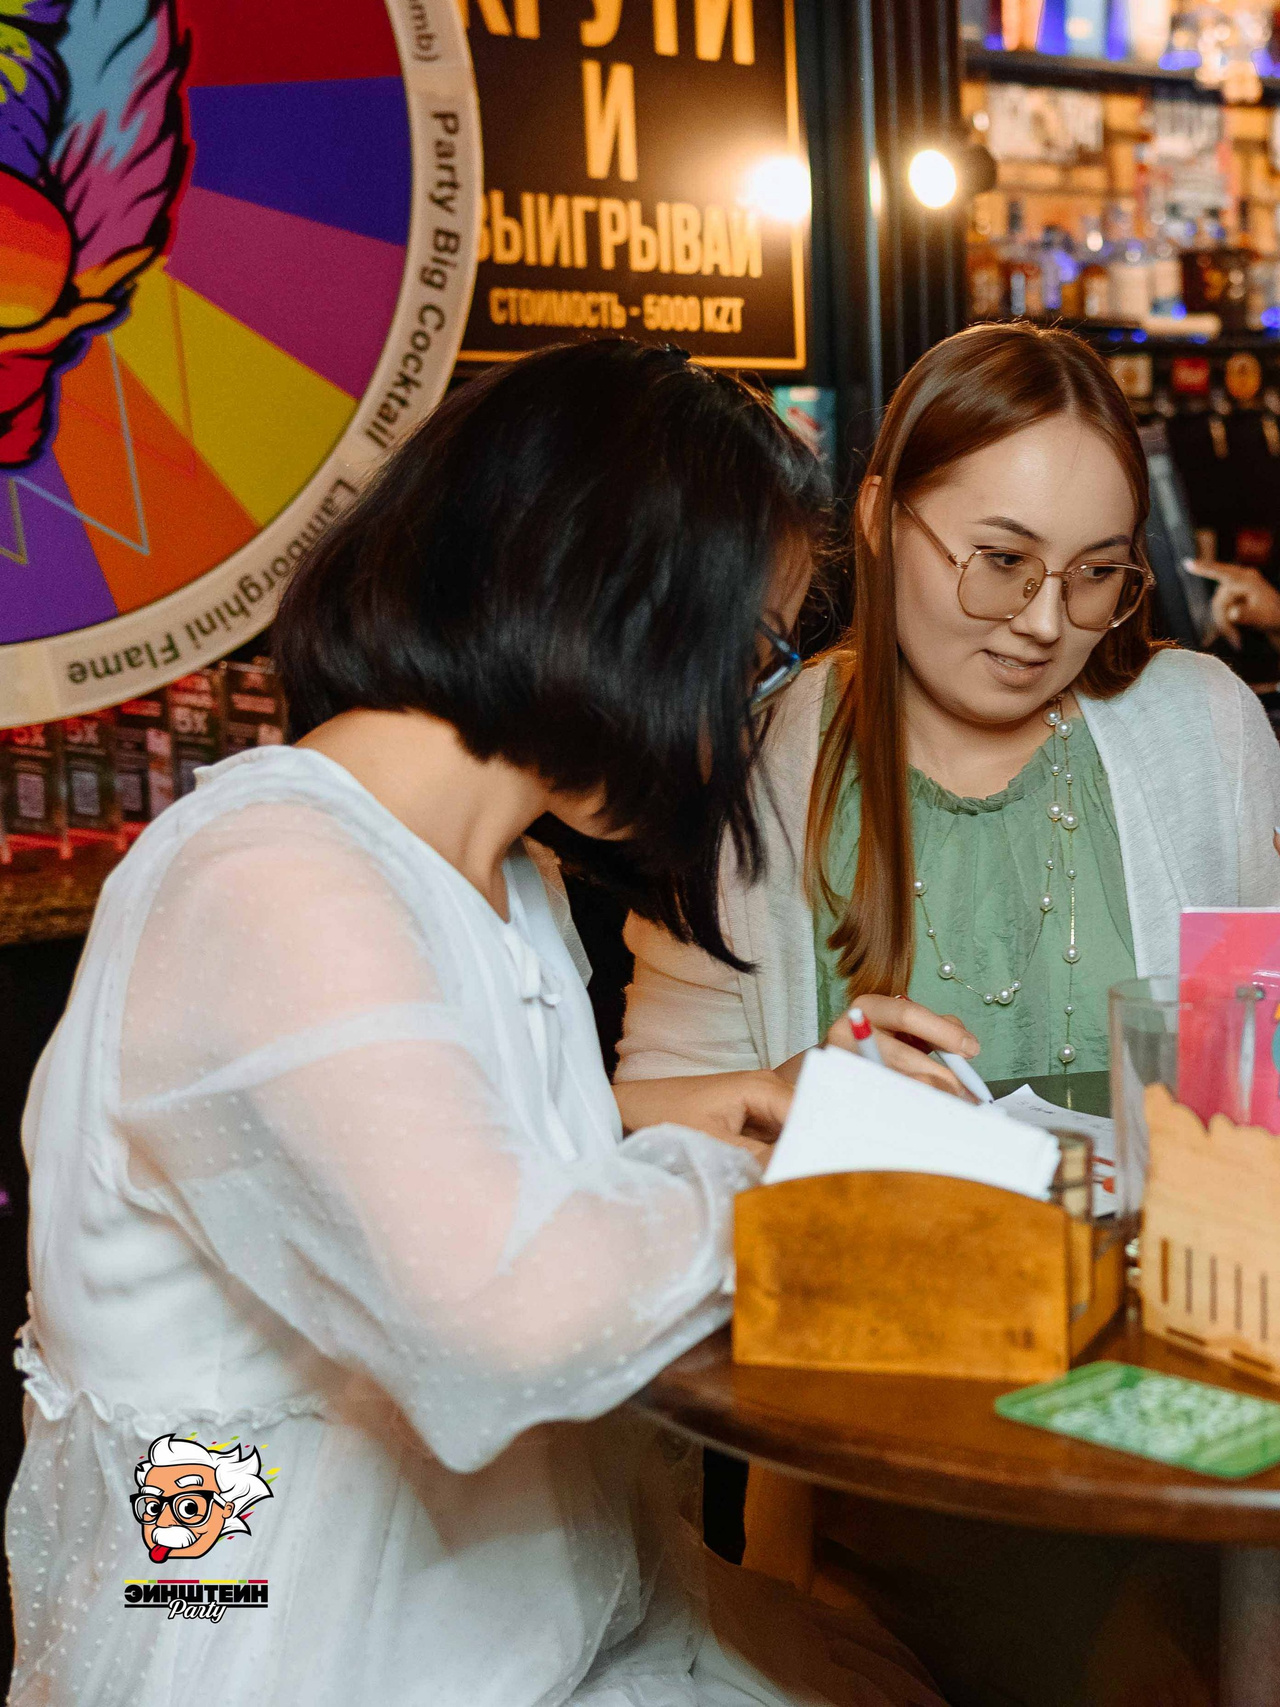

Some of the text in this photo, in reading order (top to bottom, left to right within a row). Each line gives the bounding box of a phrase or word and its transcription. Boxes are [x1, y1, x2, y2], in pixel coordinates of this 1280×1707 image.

[581, 59, 638, 182] И
[364, 111, 461, 450] Party Big Cocktail
[490, 287, 627, 330] СТОИМОСТЬ
[703, 297, 745, 334] KZT
[66, 632, 181, 684] Flame
